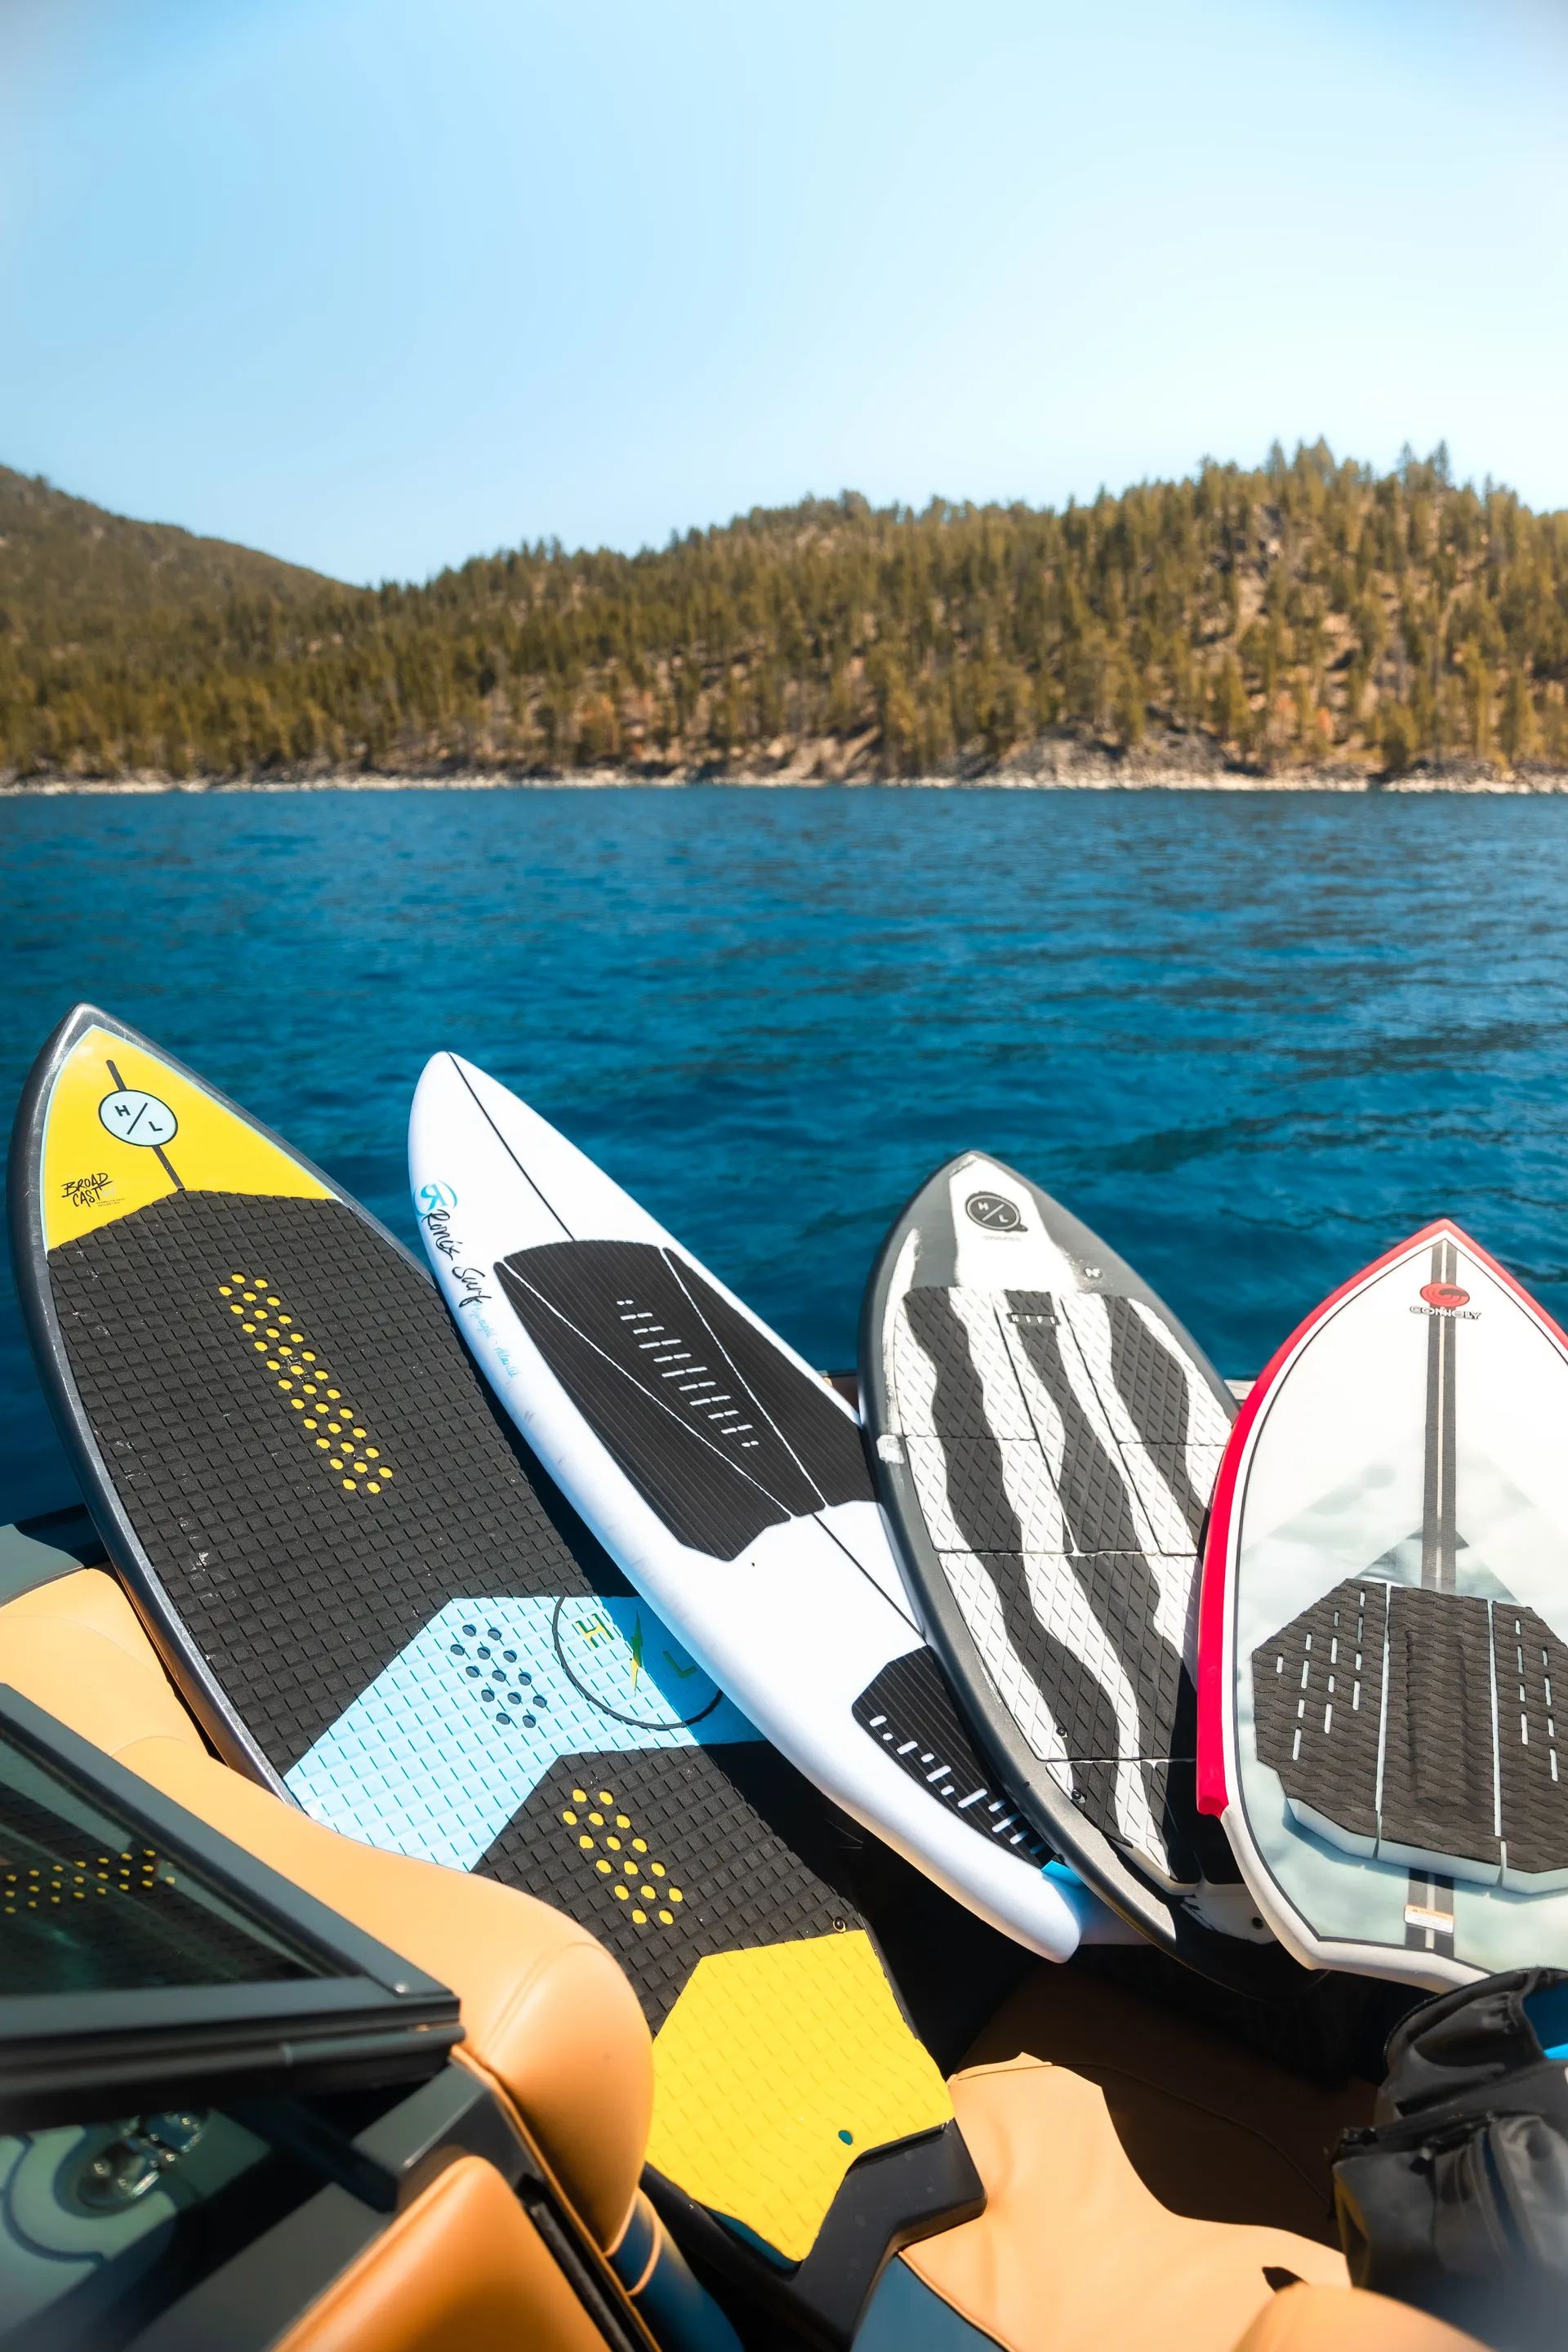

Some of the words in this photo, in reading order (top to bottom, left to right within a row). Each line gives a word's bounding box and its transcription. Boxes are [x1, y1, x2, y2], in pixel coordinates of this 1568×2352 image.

[61, 1172, 109, 1198] BROAD
[72, 1180, 114, 1208] CAST
[421, 1209, 463, 1261] Ronix
[451, 1266, 492, 1307] Surf
[575, 1613, 615, 1648] H
[662, 1650, 697, 1678] L
